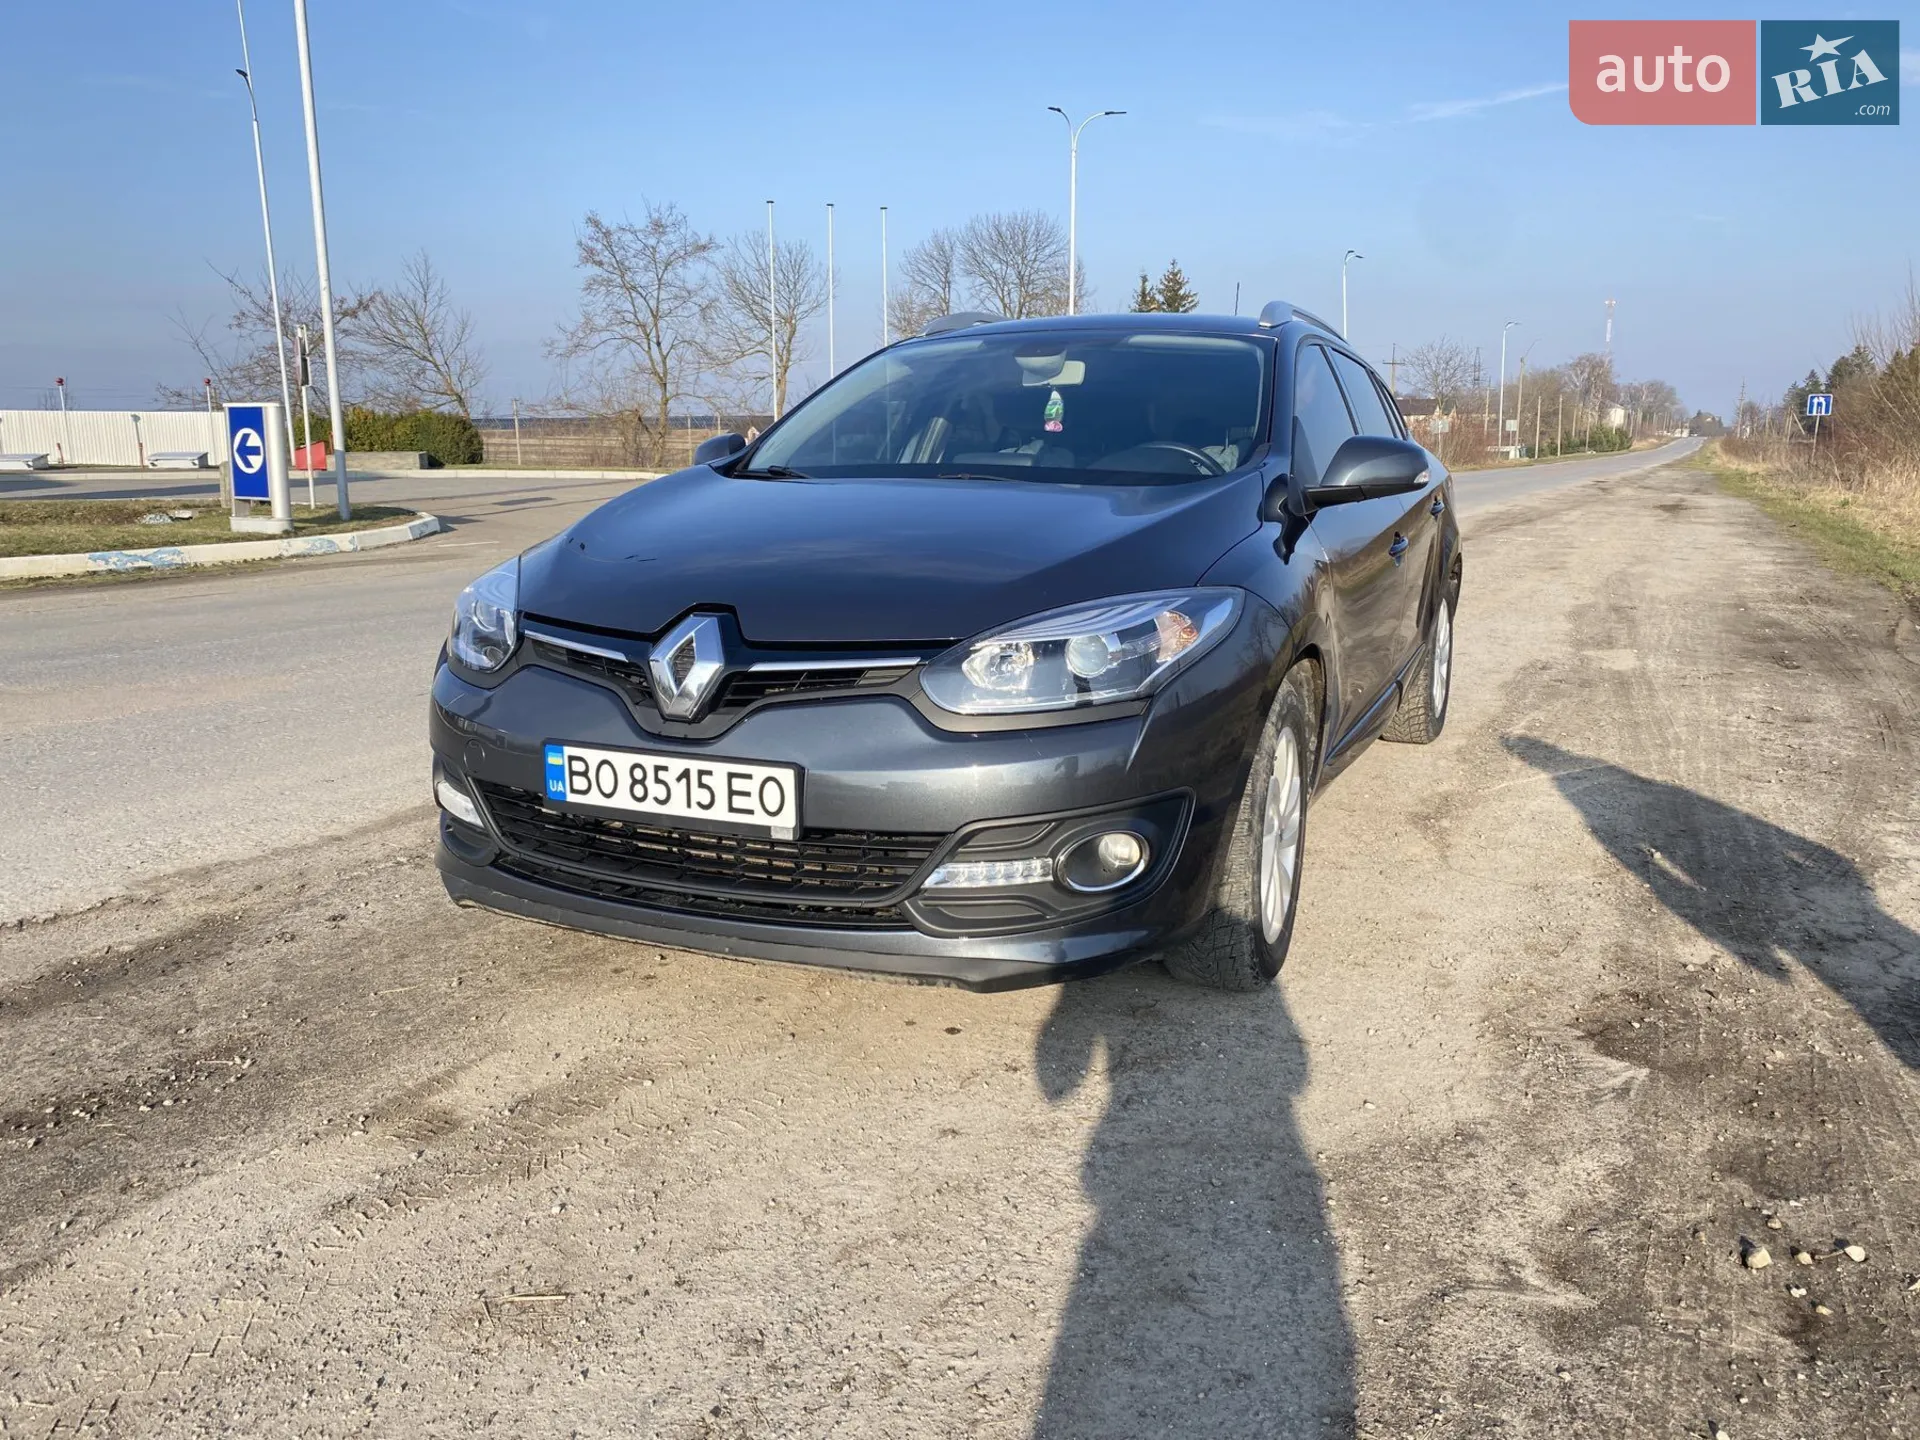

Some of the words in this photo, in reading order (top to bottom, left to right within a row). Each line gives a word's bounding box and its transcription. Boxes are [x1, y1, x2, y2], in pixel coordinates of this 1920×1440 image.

[549, 779, 566, 793] UA
[567, 754, 619, 799] BO
[628, 762, 716, 811] 8515
[726, 771, 786, 818] EO
